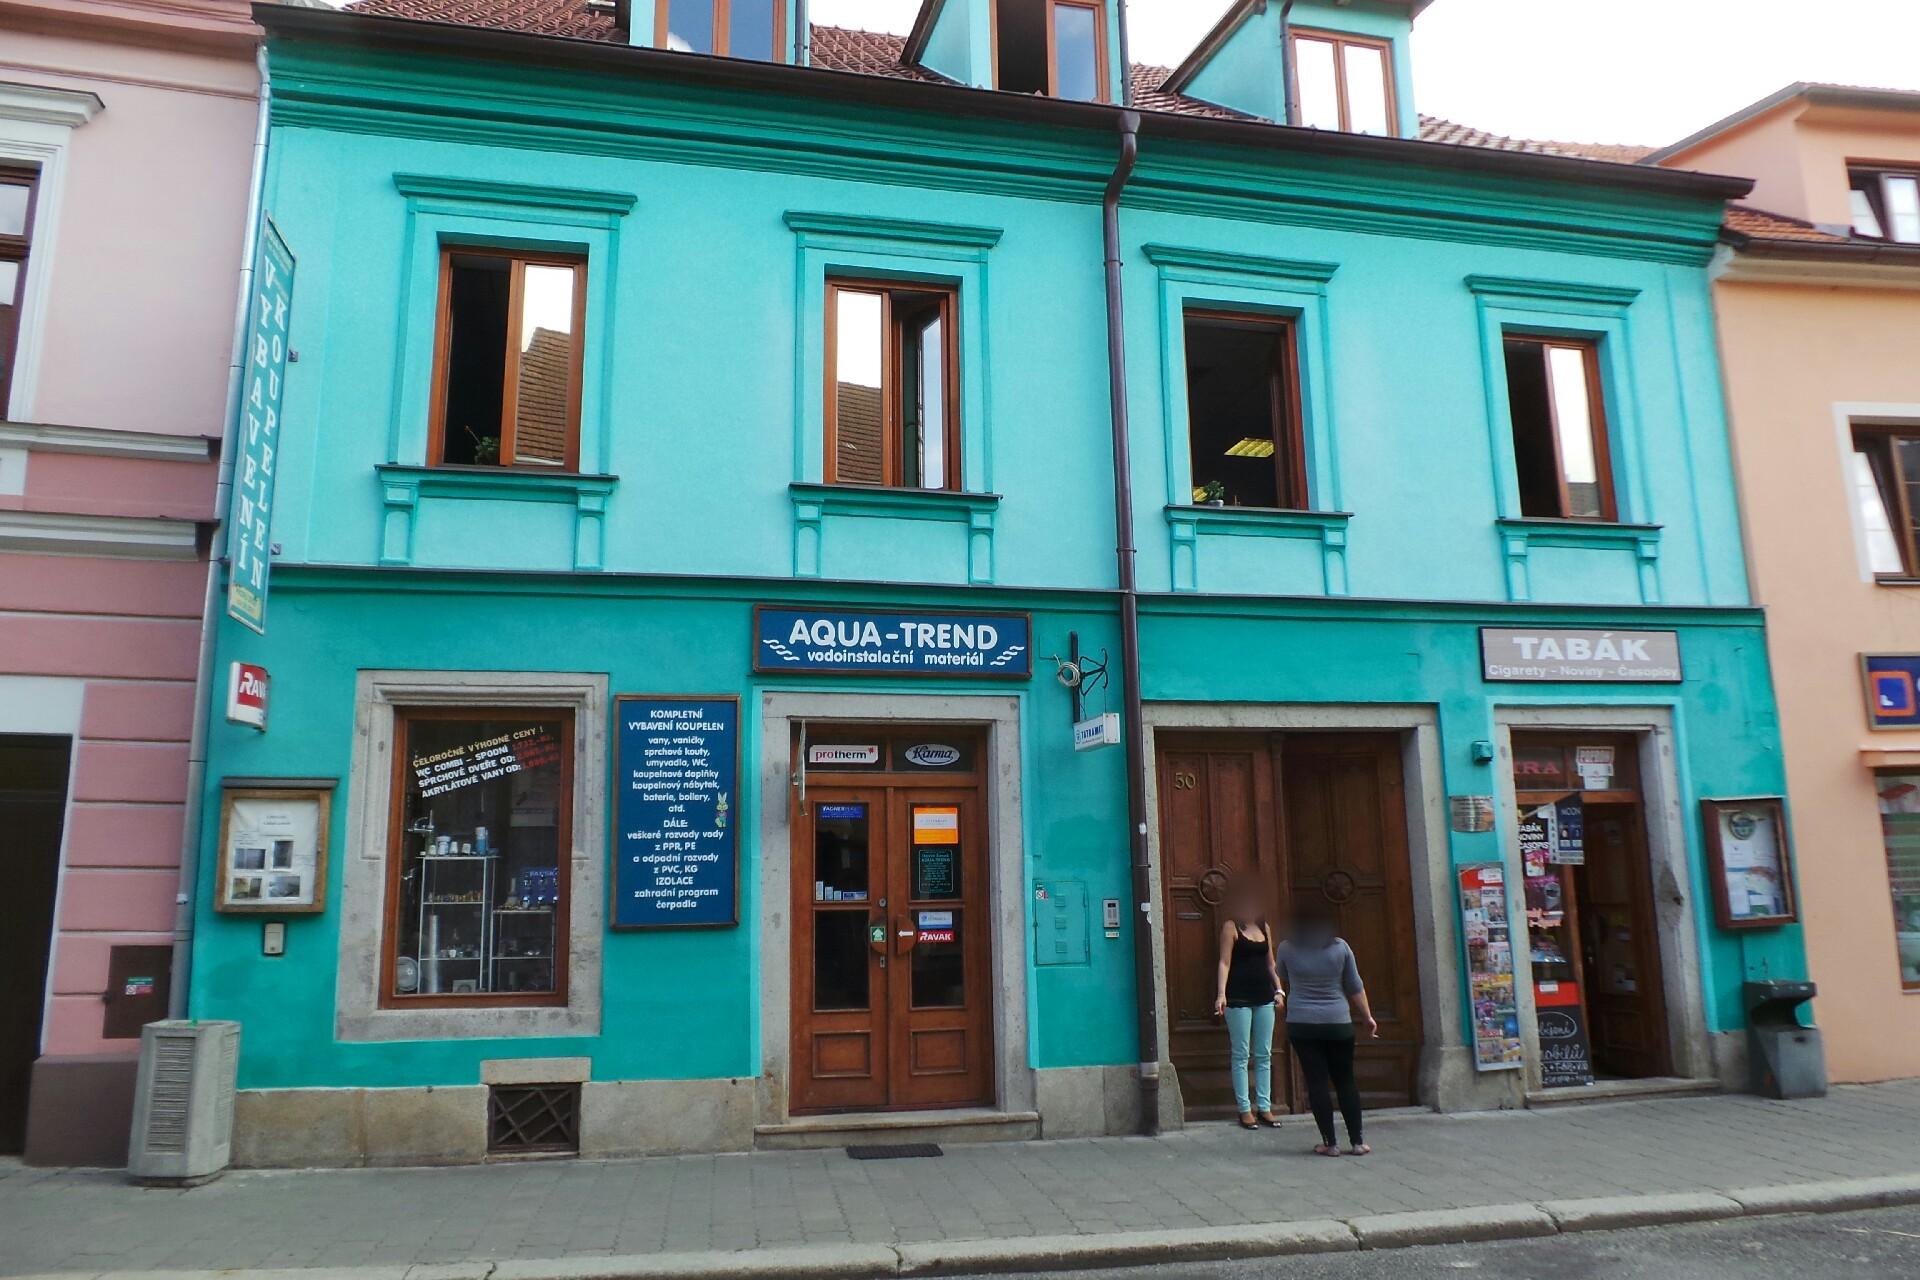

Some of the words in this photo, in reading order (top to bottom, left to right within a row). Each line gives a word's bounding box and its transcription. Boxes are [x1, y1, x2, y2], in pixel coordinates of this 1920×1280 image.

[238, 255, 276, 570] VYBAVENÍ
[251, 294, 288, 589] KOUPELEN
[1512, 633, 1650, 661] TABÁK
[807, 649, 914, 664] vodoinstalační
[924, 652, 984, 666] materiál
[1488, 664, 1546, 678] Cigarety
[1560, 666, 1604, 678] Noviny
[1618, 664, 1679, 678] Časopisy
[650, 708, 704, 719] KOMPLETNÍ
[628, 719, 674, 731] VYBAVENÍ
[676, 722, 724, 731] KOUPELEN
[468, 734, 511, 752] VÝHODNÉ
[513, 727, 537, 740] CENY
[648, 737, 671, 746] vany,
[672, 735, 705, 746] vaničky
[644, 746, 683, 757] sprchové
[684, 747, 711, 757] kouty,
[815, 749, 867, 761] protherm
[912, 745, 954, 762] Karma
[416, 767, 432, 778] WC
[434, 758, 464, 773] COMBI
[475, 744, 509, 761] SPODNÍ
[646, 758, 690, 768] umyvadla,
[692, 758, 709, 768] WC,
[418, 766, 466, 788] SPRCHOVÉ
[468, 757, 498, 773] DVEŘE
[500, 754, 516, 765] OD:
[633, 769, 683, 779] koupelnové
[684, 769, 719, 779] doplňky
[421, 774, 480, 798] AKRYLÁTOVÉ
[481, 768, 505, 781] VANY
[505, 763, 522, 774] OD:
[632, 780, 681, 791] koupelnový
[683, 780, 720, 790] nábytek,
[1175, 772, 1196, 790] 50
[643, 792, 676, 802] baterie,
[678, 792, 711, 803] boilery,
[668, 804, 686, 813] atd.
[663, 816, 688, 828] DÁLE:
[1519, 822, 1544, 832] ABÁK
[627, 830, 662, 840] veškeré
[665, 830, 700, 840] rozvody
[702, 829, 724, 840] vody
[662, 841, 683, 851] PPR,
[684, 841, 696, 850] PE
[633, 855, 639, 863] a
[642, 854, 681, 864] odpadní
[683, 853, 719, 863] rozvody
[653, 866, 659, 874] z
[662, 865, 683, 875] PVC,
[684, 864, 698, 873] KG
[656, 876, 694, 886] IZOLACE
[634, 887, 675, 898] zahradní
[678, 889, 719, 899] program
[656, 900, 697, 910] čerpadla
[920, 931, 952, 941] RAVAK
